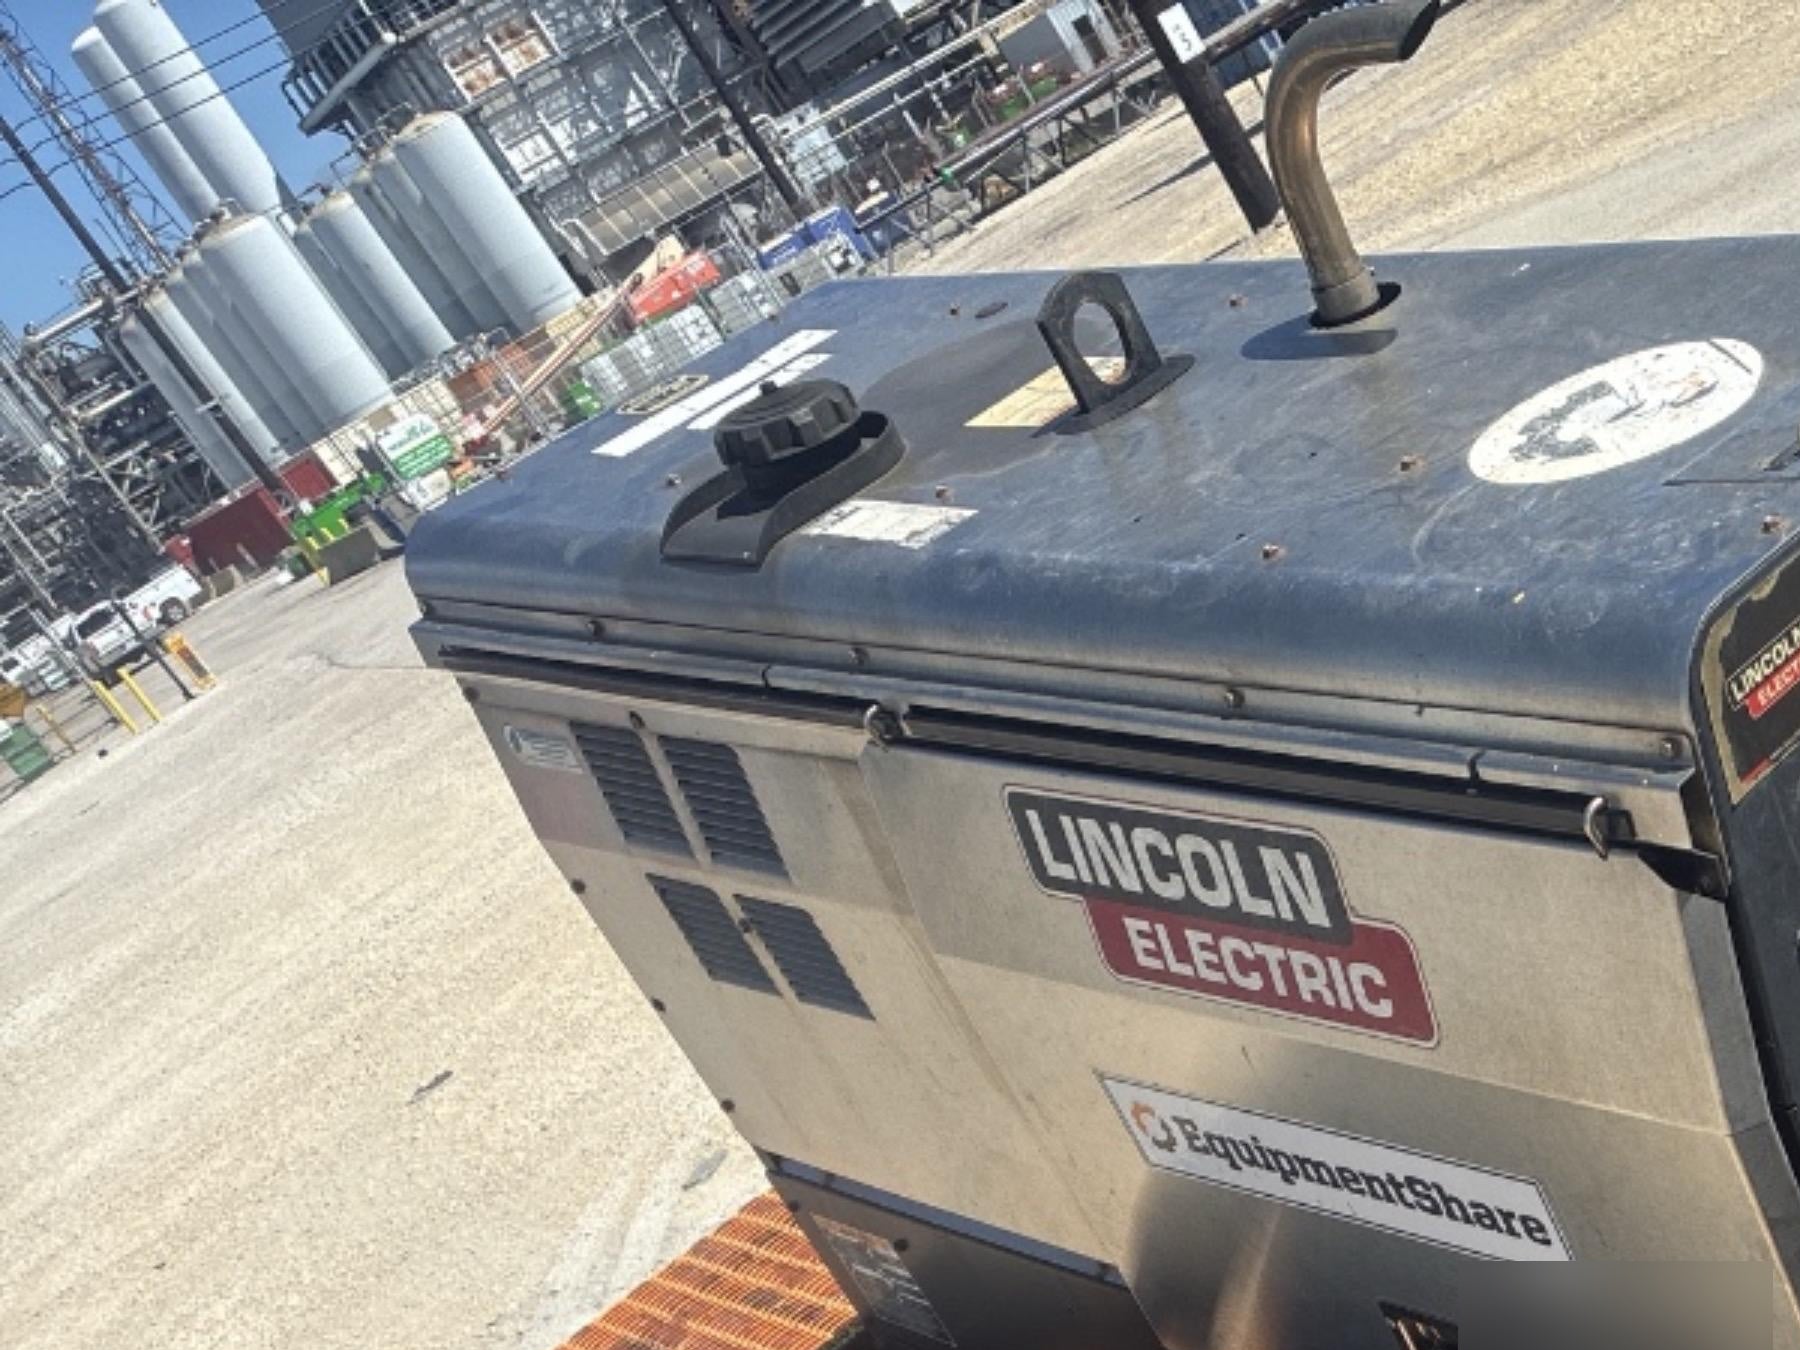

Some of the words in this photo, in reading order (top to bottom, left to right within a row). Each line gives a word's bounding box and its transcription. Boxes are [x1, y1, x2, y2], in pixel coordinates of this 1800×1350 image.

[1025, 809, 1330, 928] LINCOLN
[1122, 915, 1394, 1019] ELECTRIC
[1172, 1113, 1553, 1247] EquipmentShare
